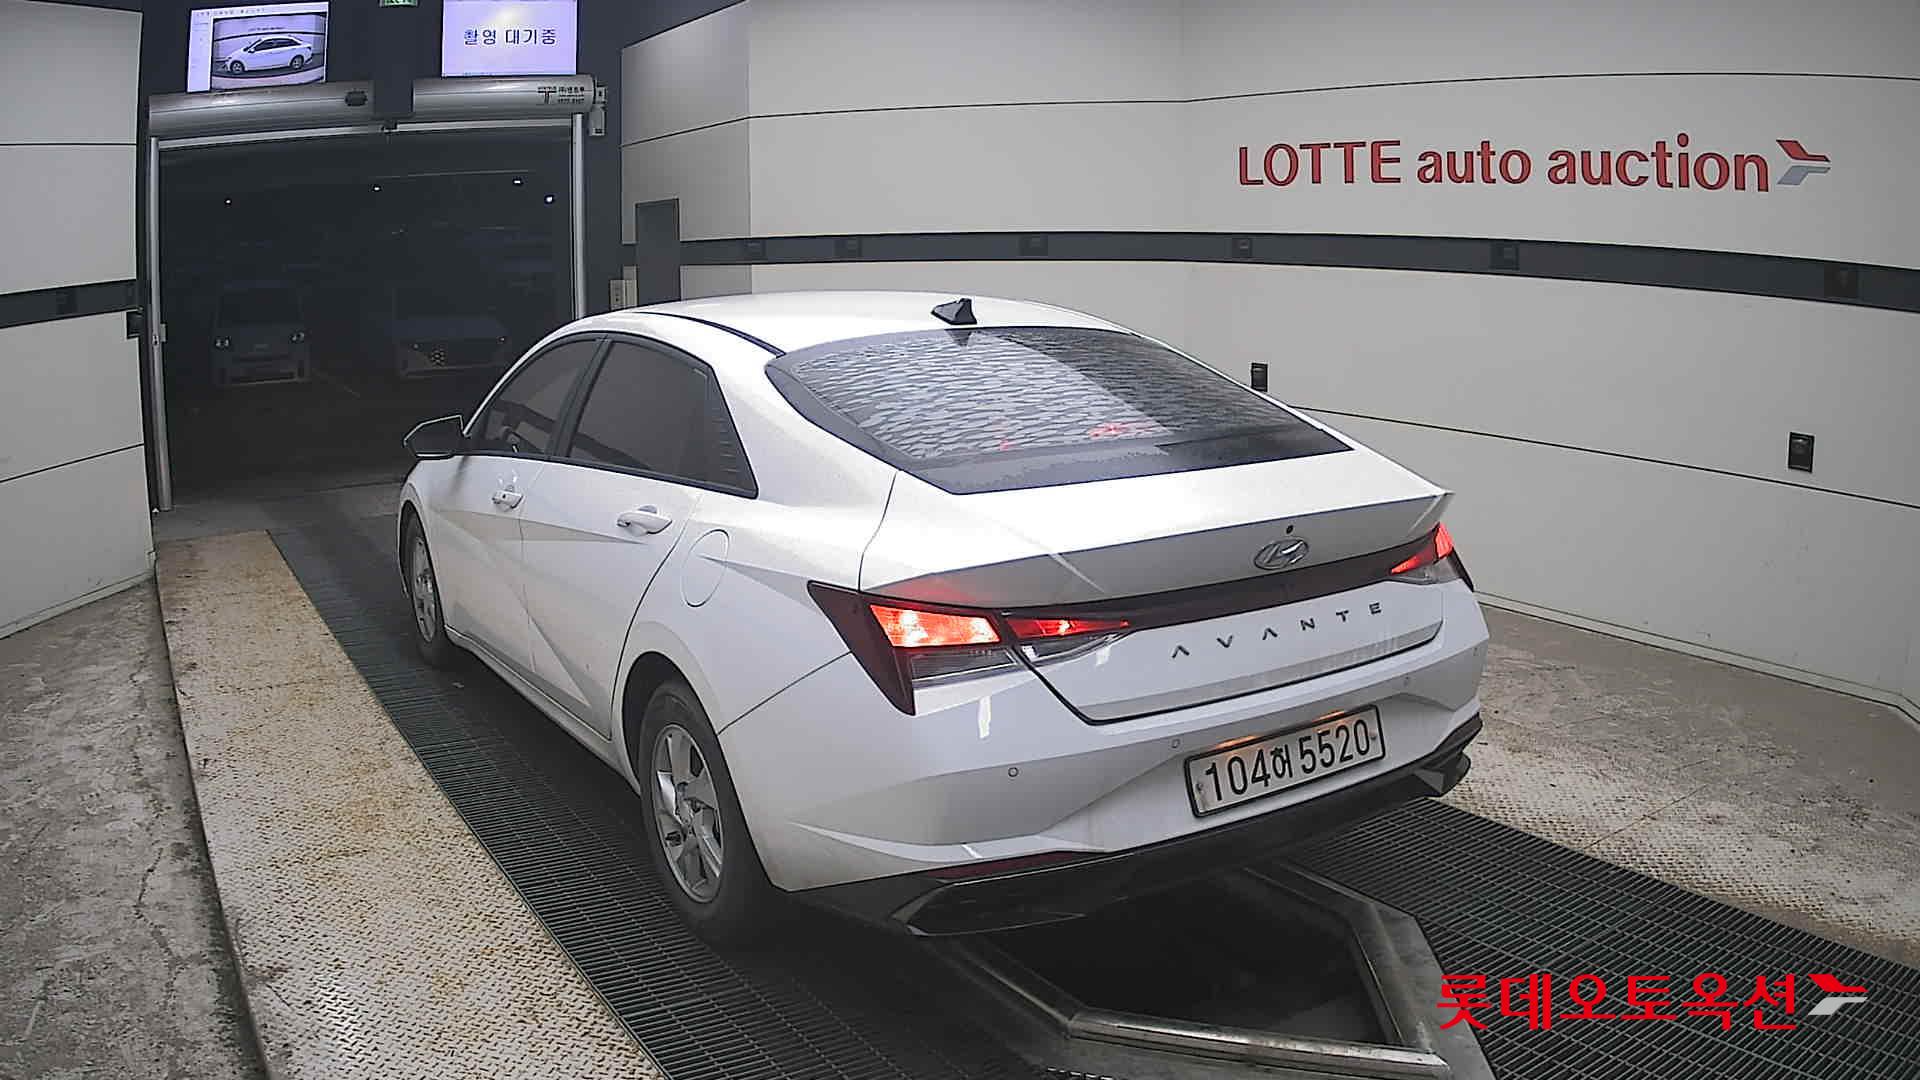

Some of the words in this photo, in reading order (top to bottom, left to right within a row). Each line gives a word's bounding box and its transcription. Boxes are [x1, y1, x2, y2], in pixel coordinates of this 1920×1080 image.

[505, 29, 556, 45] 대기중
[1239, 140, 1401, 186] LOTTE
[1416, 140, 1532, 184] auto
[1547, 132, 1769, 193] auction
[1171, 602, 1382, 659] AVANTE
[1298, 719, 1370, 774] 5520
